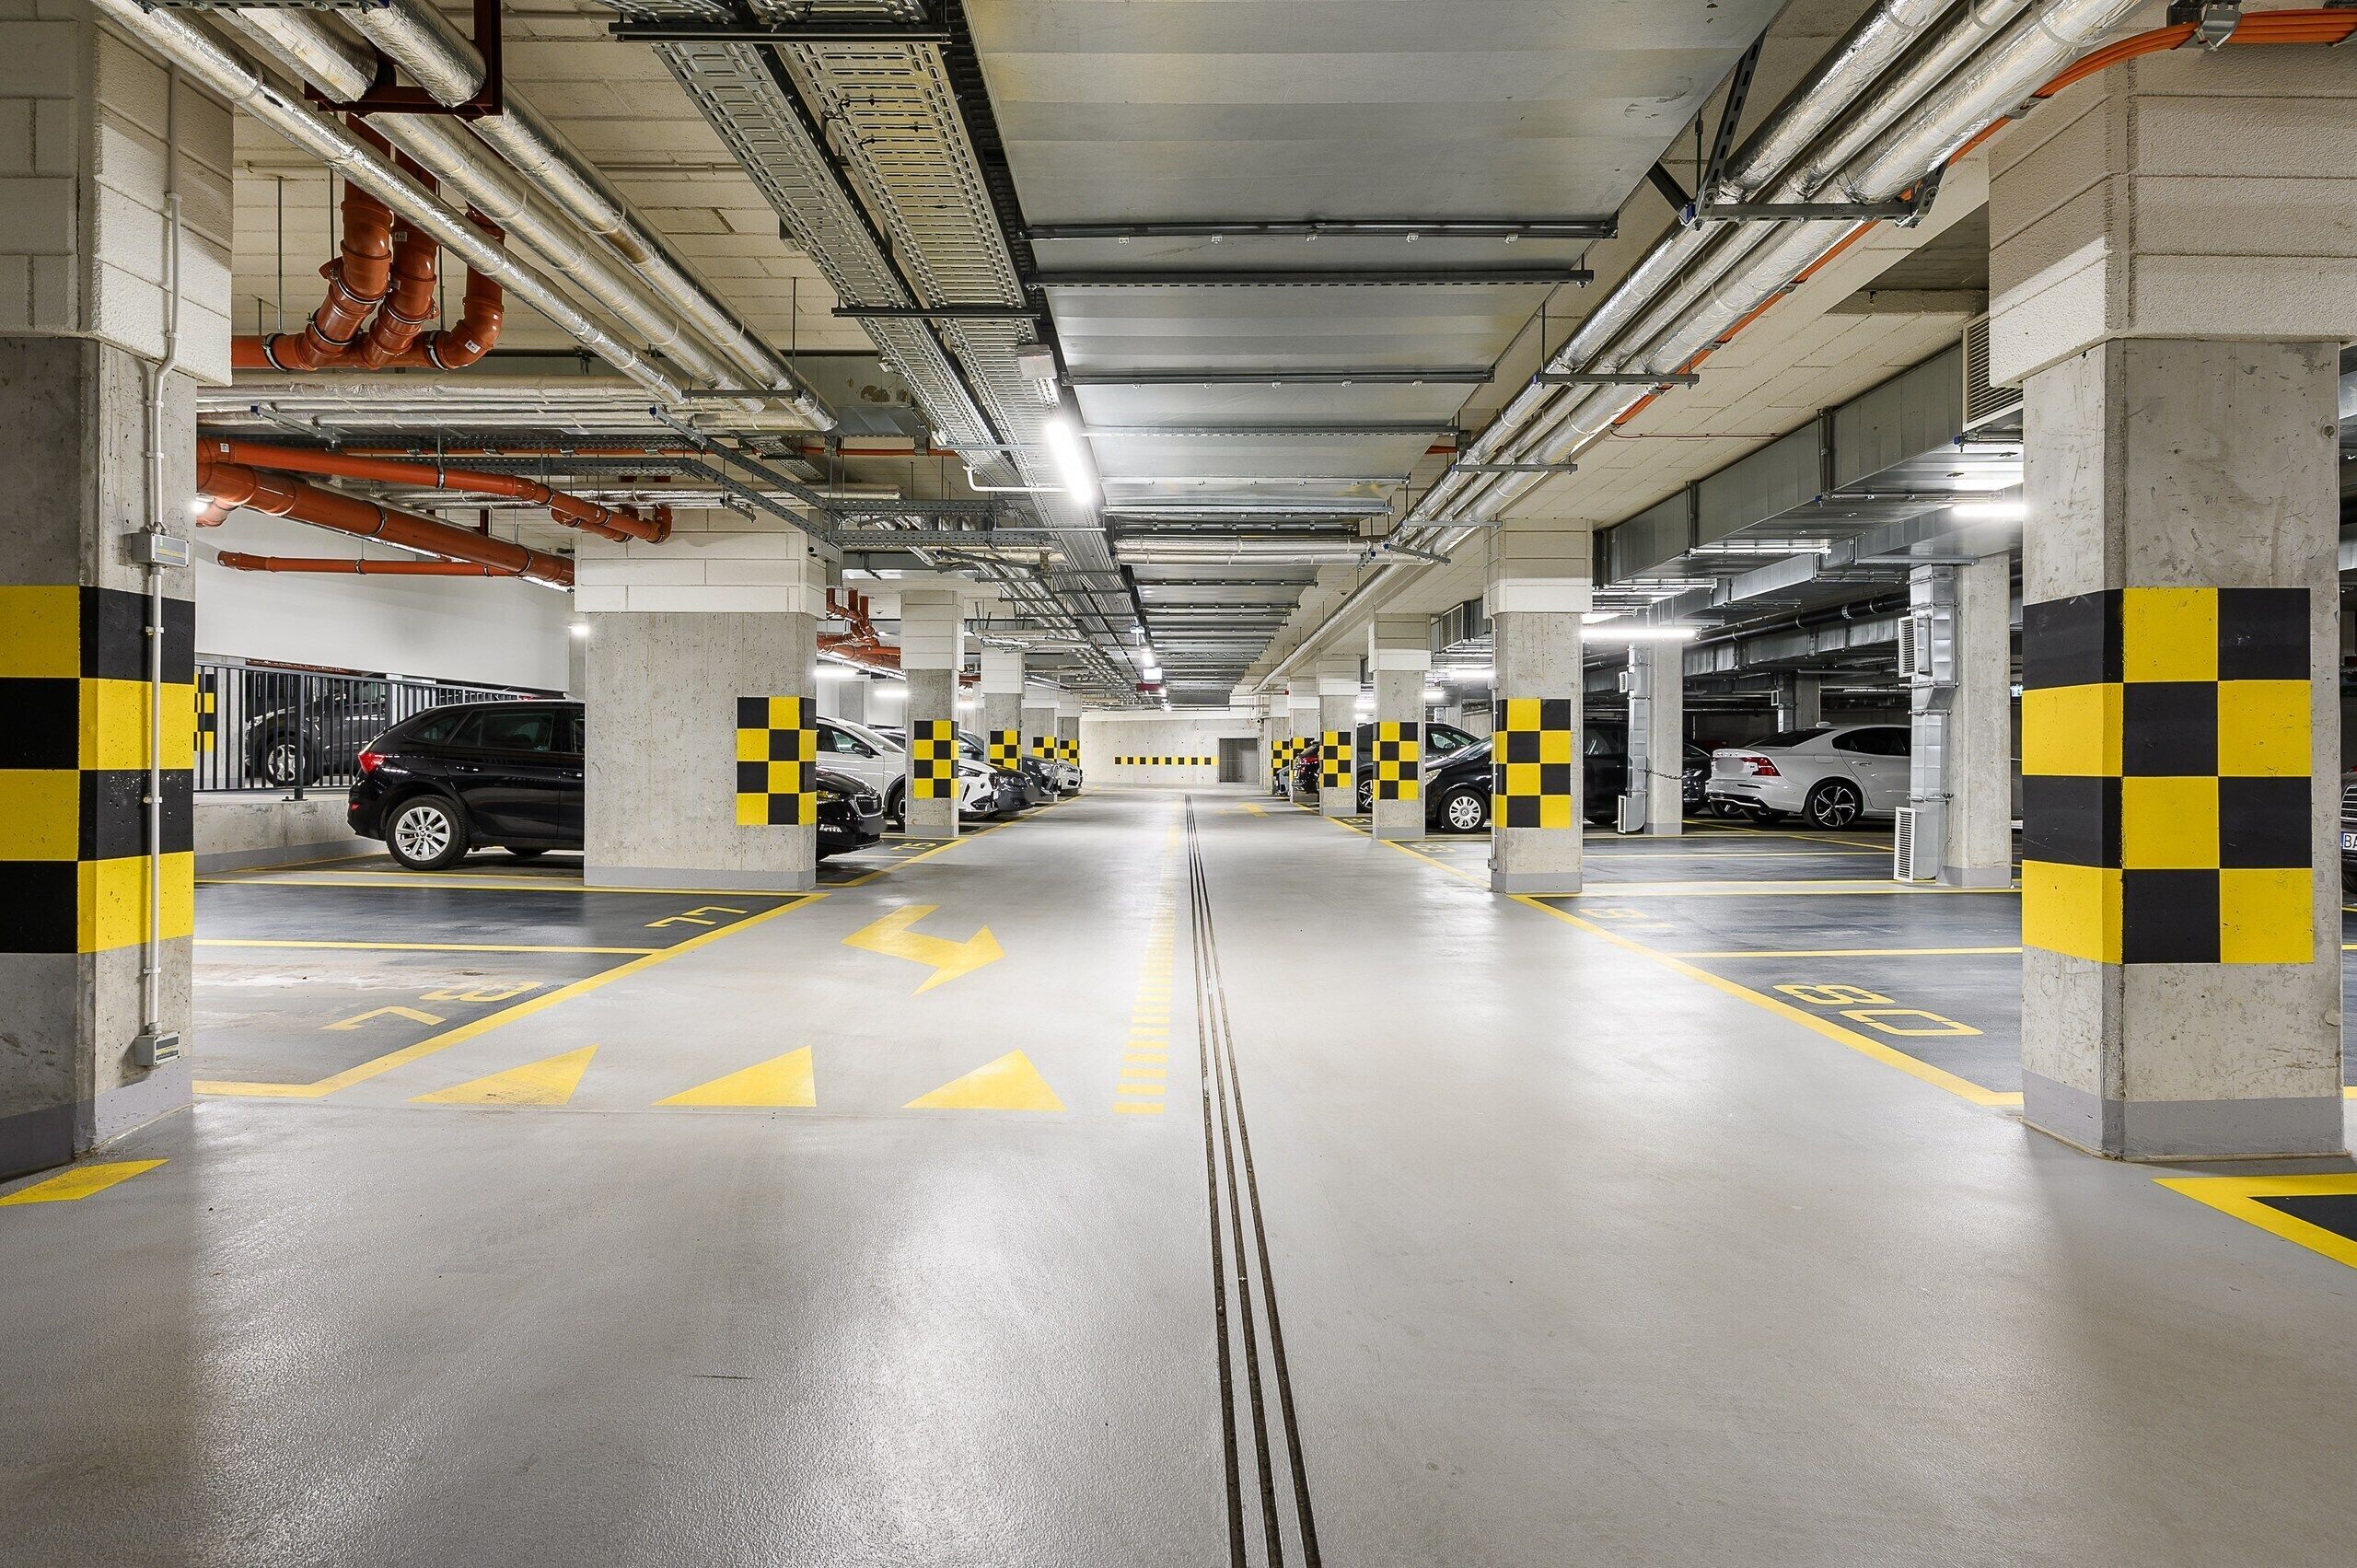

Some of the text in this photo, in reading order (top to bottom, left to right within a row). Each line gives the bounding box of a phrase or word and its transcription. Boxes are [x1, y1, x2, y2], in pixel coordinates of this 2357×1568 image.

[889, 842, 937, 851] 75
[644, 906, 749, 929] 77
[318, 981, 543, 1031] 78
[1772, 984, 1984, 1036] 80
